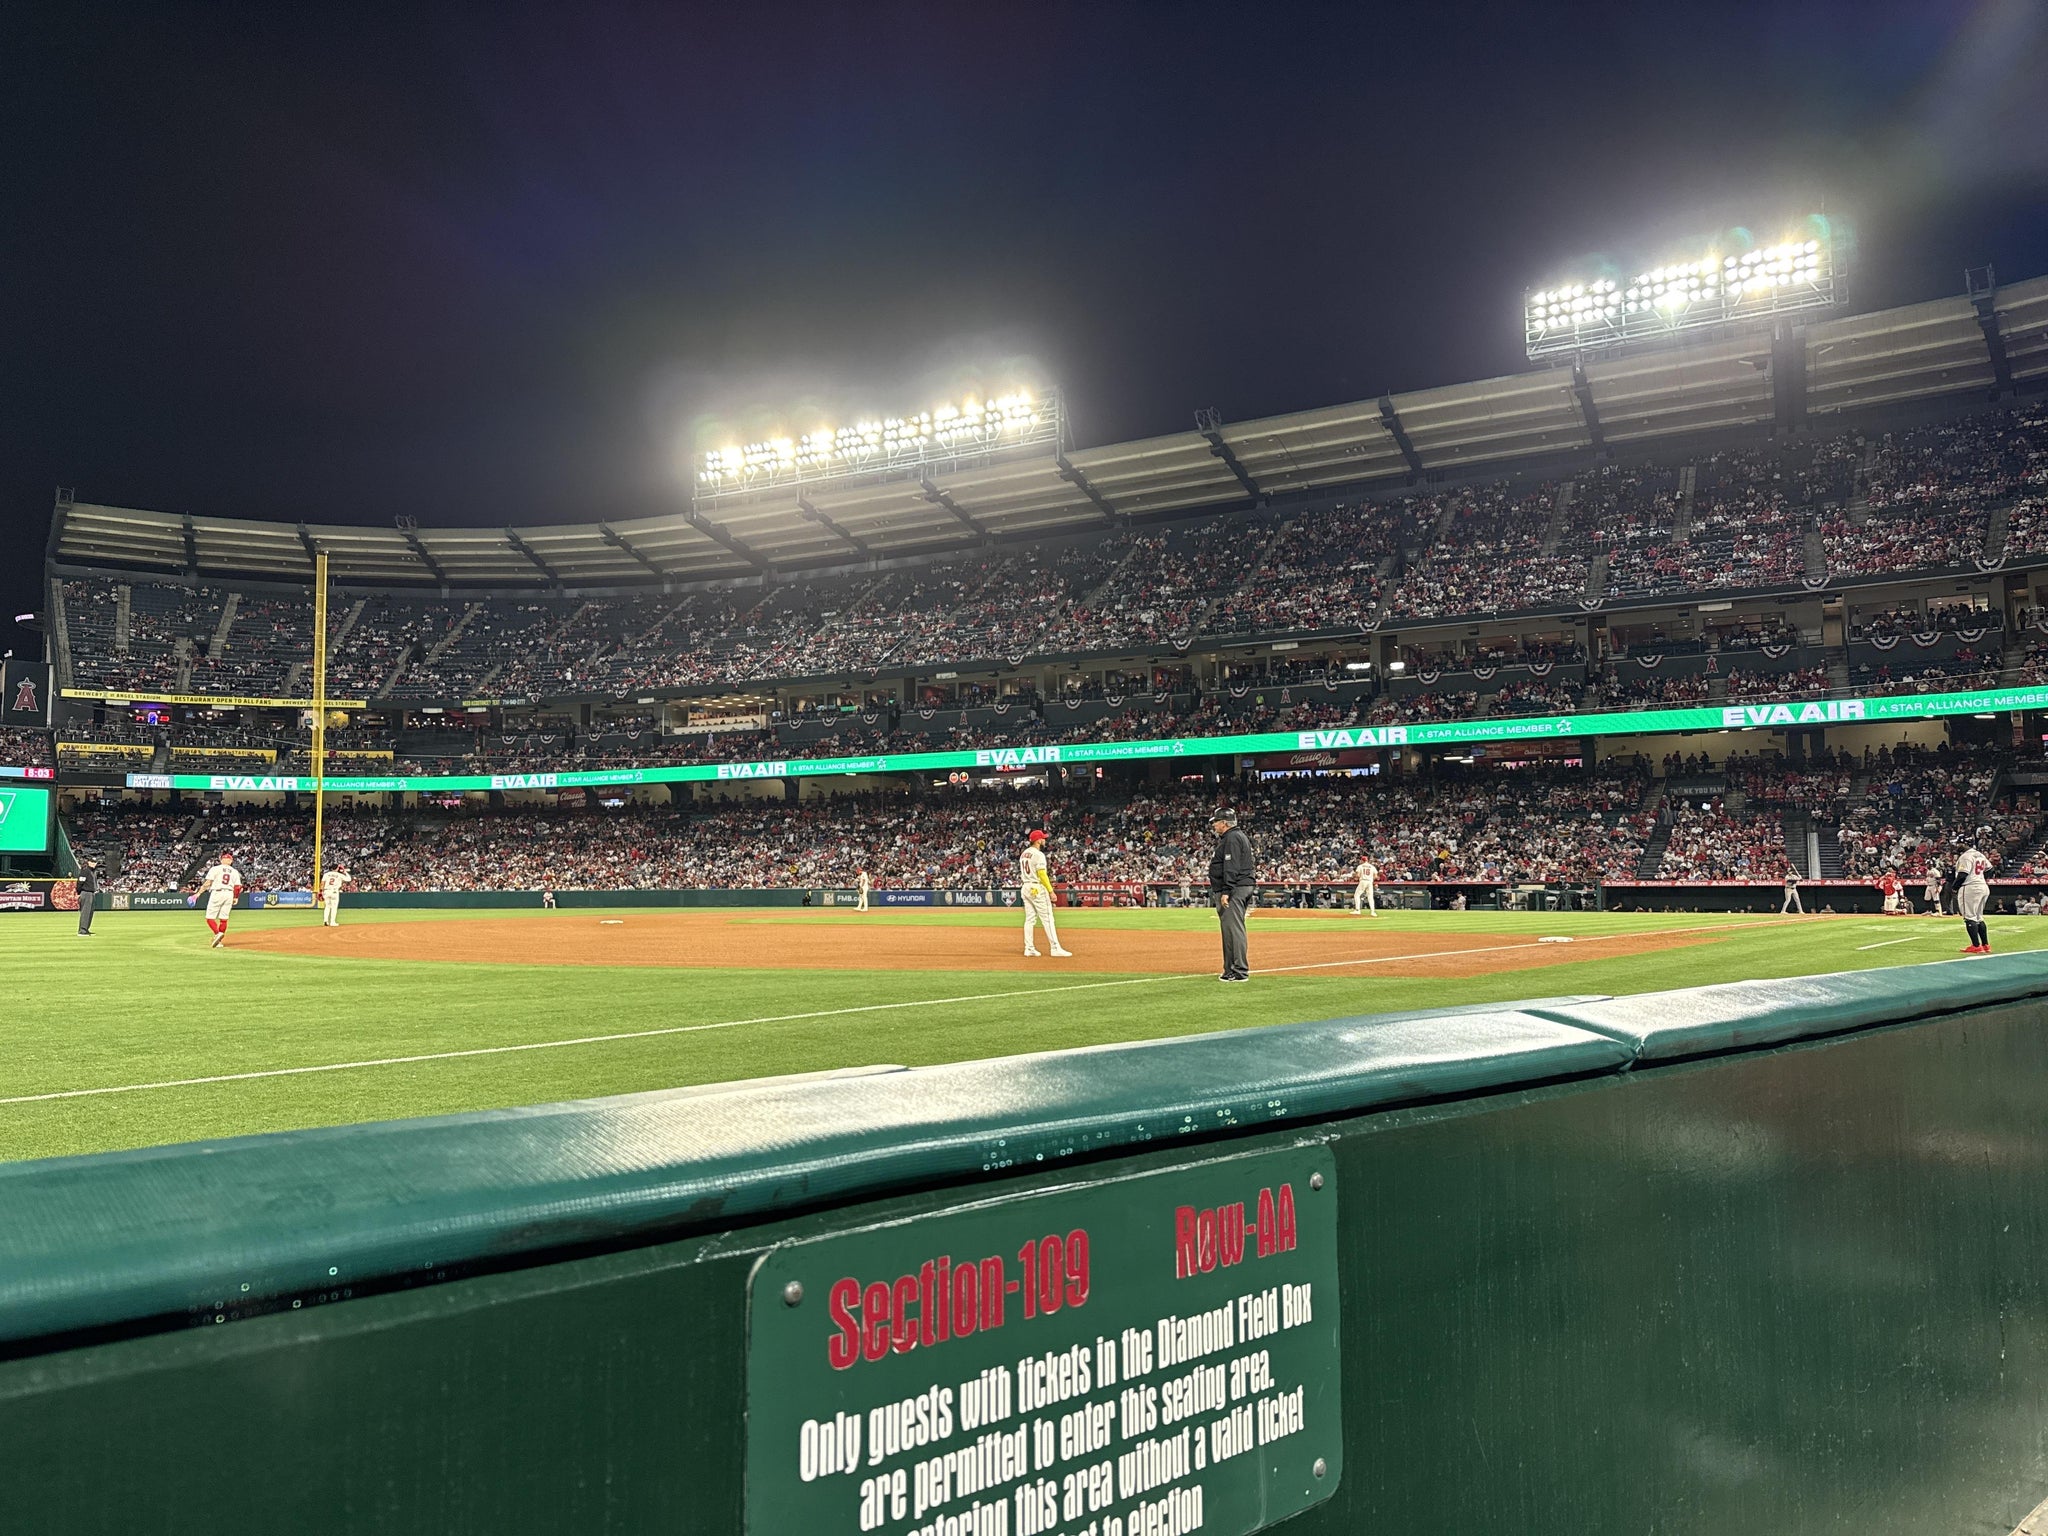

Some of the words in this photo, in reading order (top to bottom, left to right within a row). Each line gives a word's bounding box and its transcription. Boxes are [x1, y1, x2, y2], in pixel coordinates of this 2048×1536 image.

[1879, 705, 1887, 713] A
[1891, 703, 1923, 712] STAR
[1927, 698, 1991, 710] ALLIANCE
[1418, 731, 1425, 739] A
[1427, 730, 1452, 738] STAR
[1454, 727, 1504, 737] ALLIANCE
[1507, 724, 1552, 734] MEMBER
[1096, 748, 1133, 756] ALLIANCE
[1135, 746, 1169, 754] MEMBER
[847, 761, 874, 769] MEMBER
[1290, 753, 1322, 766] Classic
[560, 792, 585, 801] Classic
[222, 873, 231, 885] 9
[134, 897, 183, 905] FMB.com
[267, 894, 278, 902] 811
[956, 892, 982, 904] Modelo
[828, 1229, 1091, 1371] Section-109
[1175, 1183, 1297, 1281] Row-AA
[799, 1411, 861, 1484] Only
[867, 1384, 953, 1467] guests
[960, 1365, 1011, 1434] with
[1017, 1343, 1092, 1413] tickets
[1096, 1335, 1117, 1388] in
[1121, 1327, 1154, 1381] the
[1157, 1300, 1234, 1370] Diamond
[1238, 1292, 1279, 1345] Field
[1282, 1282, 1312, 1330] Box
[859, 1466, 907, 1532] are
[914, 1422, 1029, 1520] permitted
[1033, 1418, 1055, 1470] to
[1060, 1408, 1117, 1461] enter
[1120, 1384, 1158, 1441] this
[1161, 1364, 1227, 1426] seating
[1230, 1348, 1276, 1401] area.
[1014, 1477, 1059, 1536] this
[1063, 1460, 1114, 1522] area
[1118, 1425, 1191, 1500] without
[1194, 1426, 1207, 1471] a
[1211, 1411, 1254, 1466] valid
[1257, 1384, 1306, 1446] ticket
[1127, 1484, 1205, 1536] ejection
